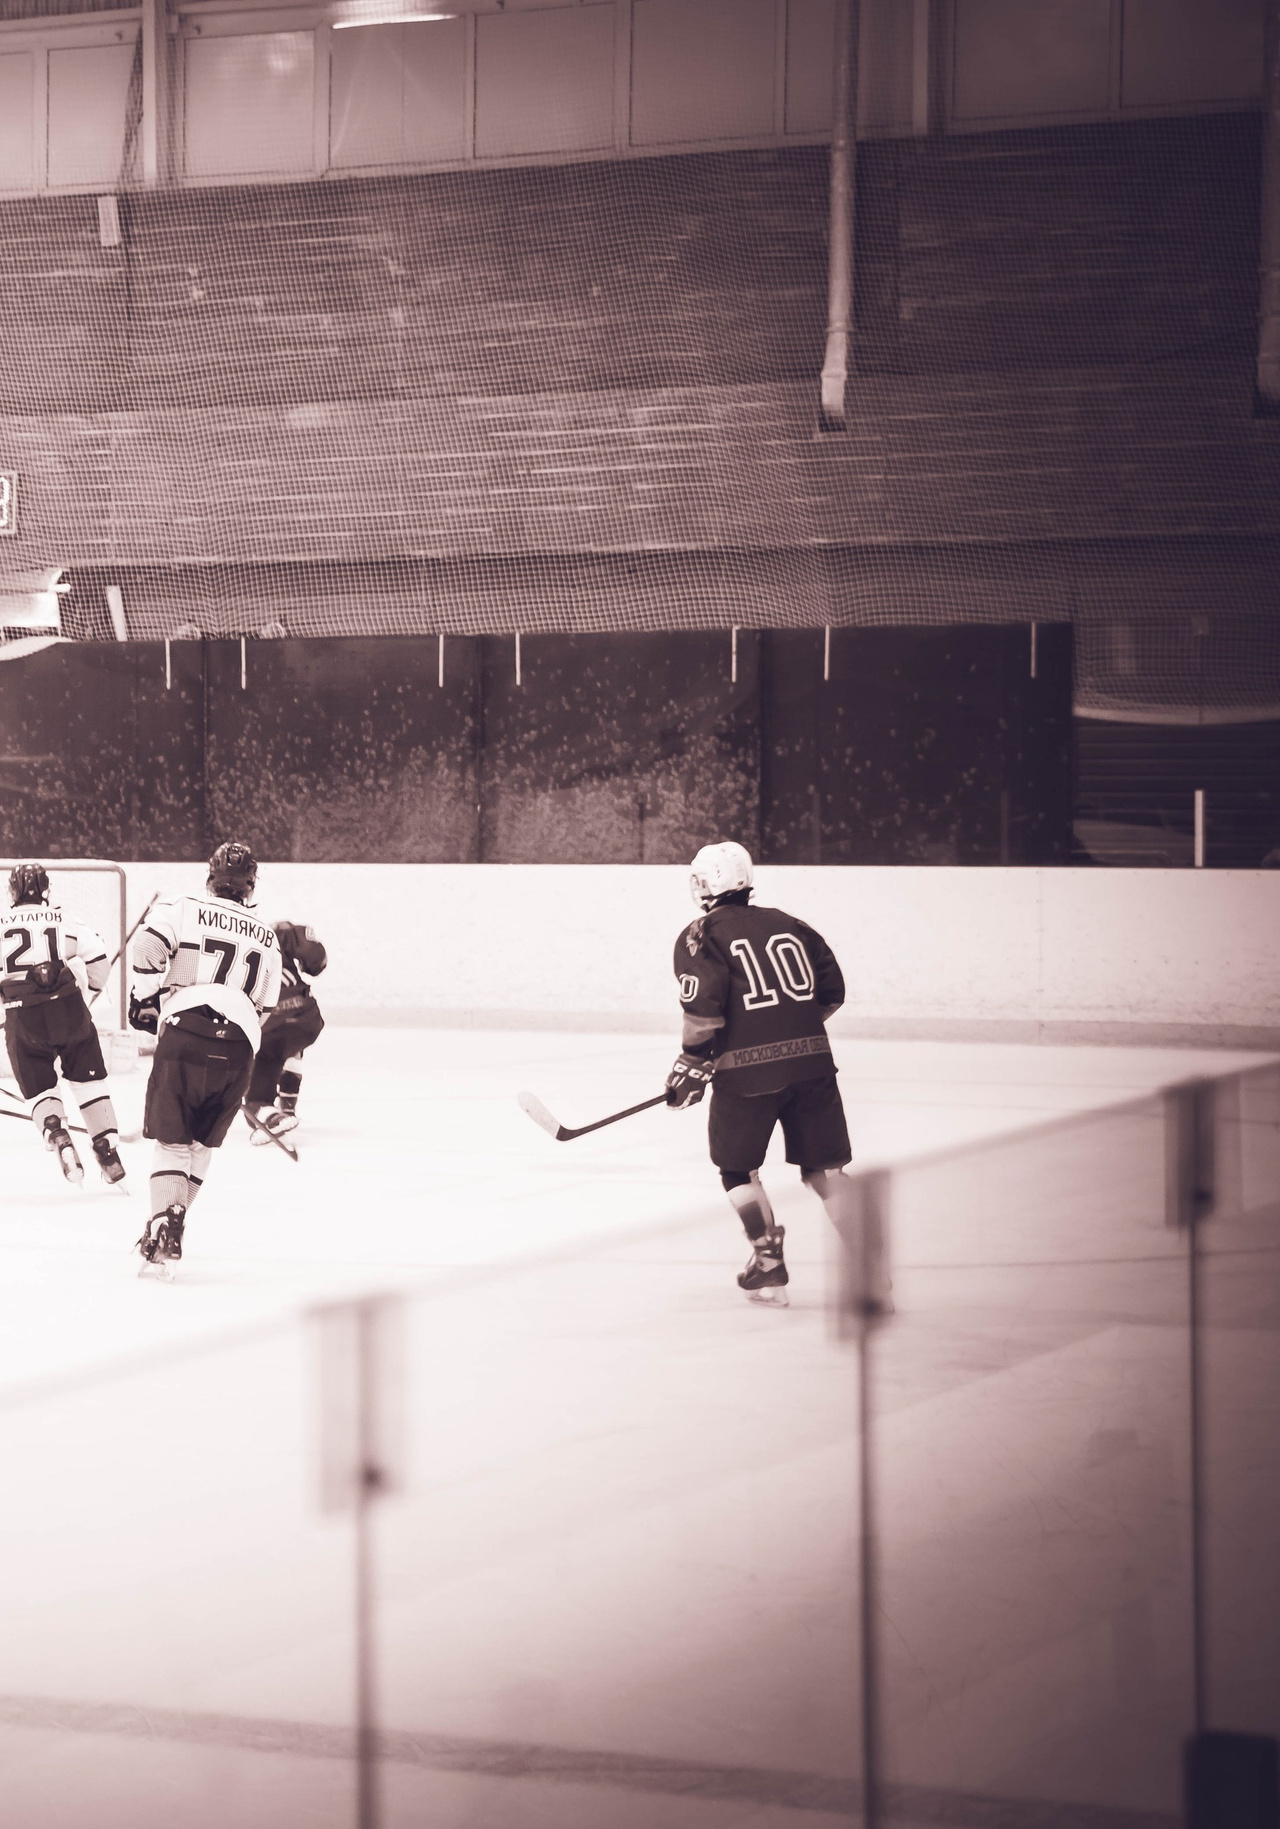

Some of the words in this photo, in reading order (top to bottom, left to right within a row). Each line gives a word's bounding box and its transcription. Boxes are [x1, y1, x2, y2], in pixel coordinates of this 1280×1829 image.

[1, 925, 66, 977] 21
[197, 908, 275, 948] КИСЛЯКОВ
[202, 935, 264, 1006] 71
[729, 932, 815, 1011] 10
[732, 1039, 810, 1067] МОСКОВСКАЯ
